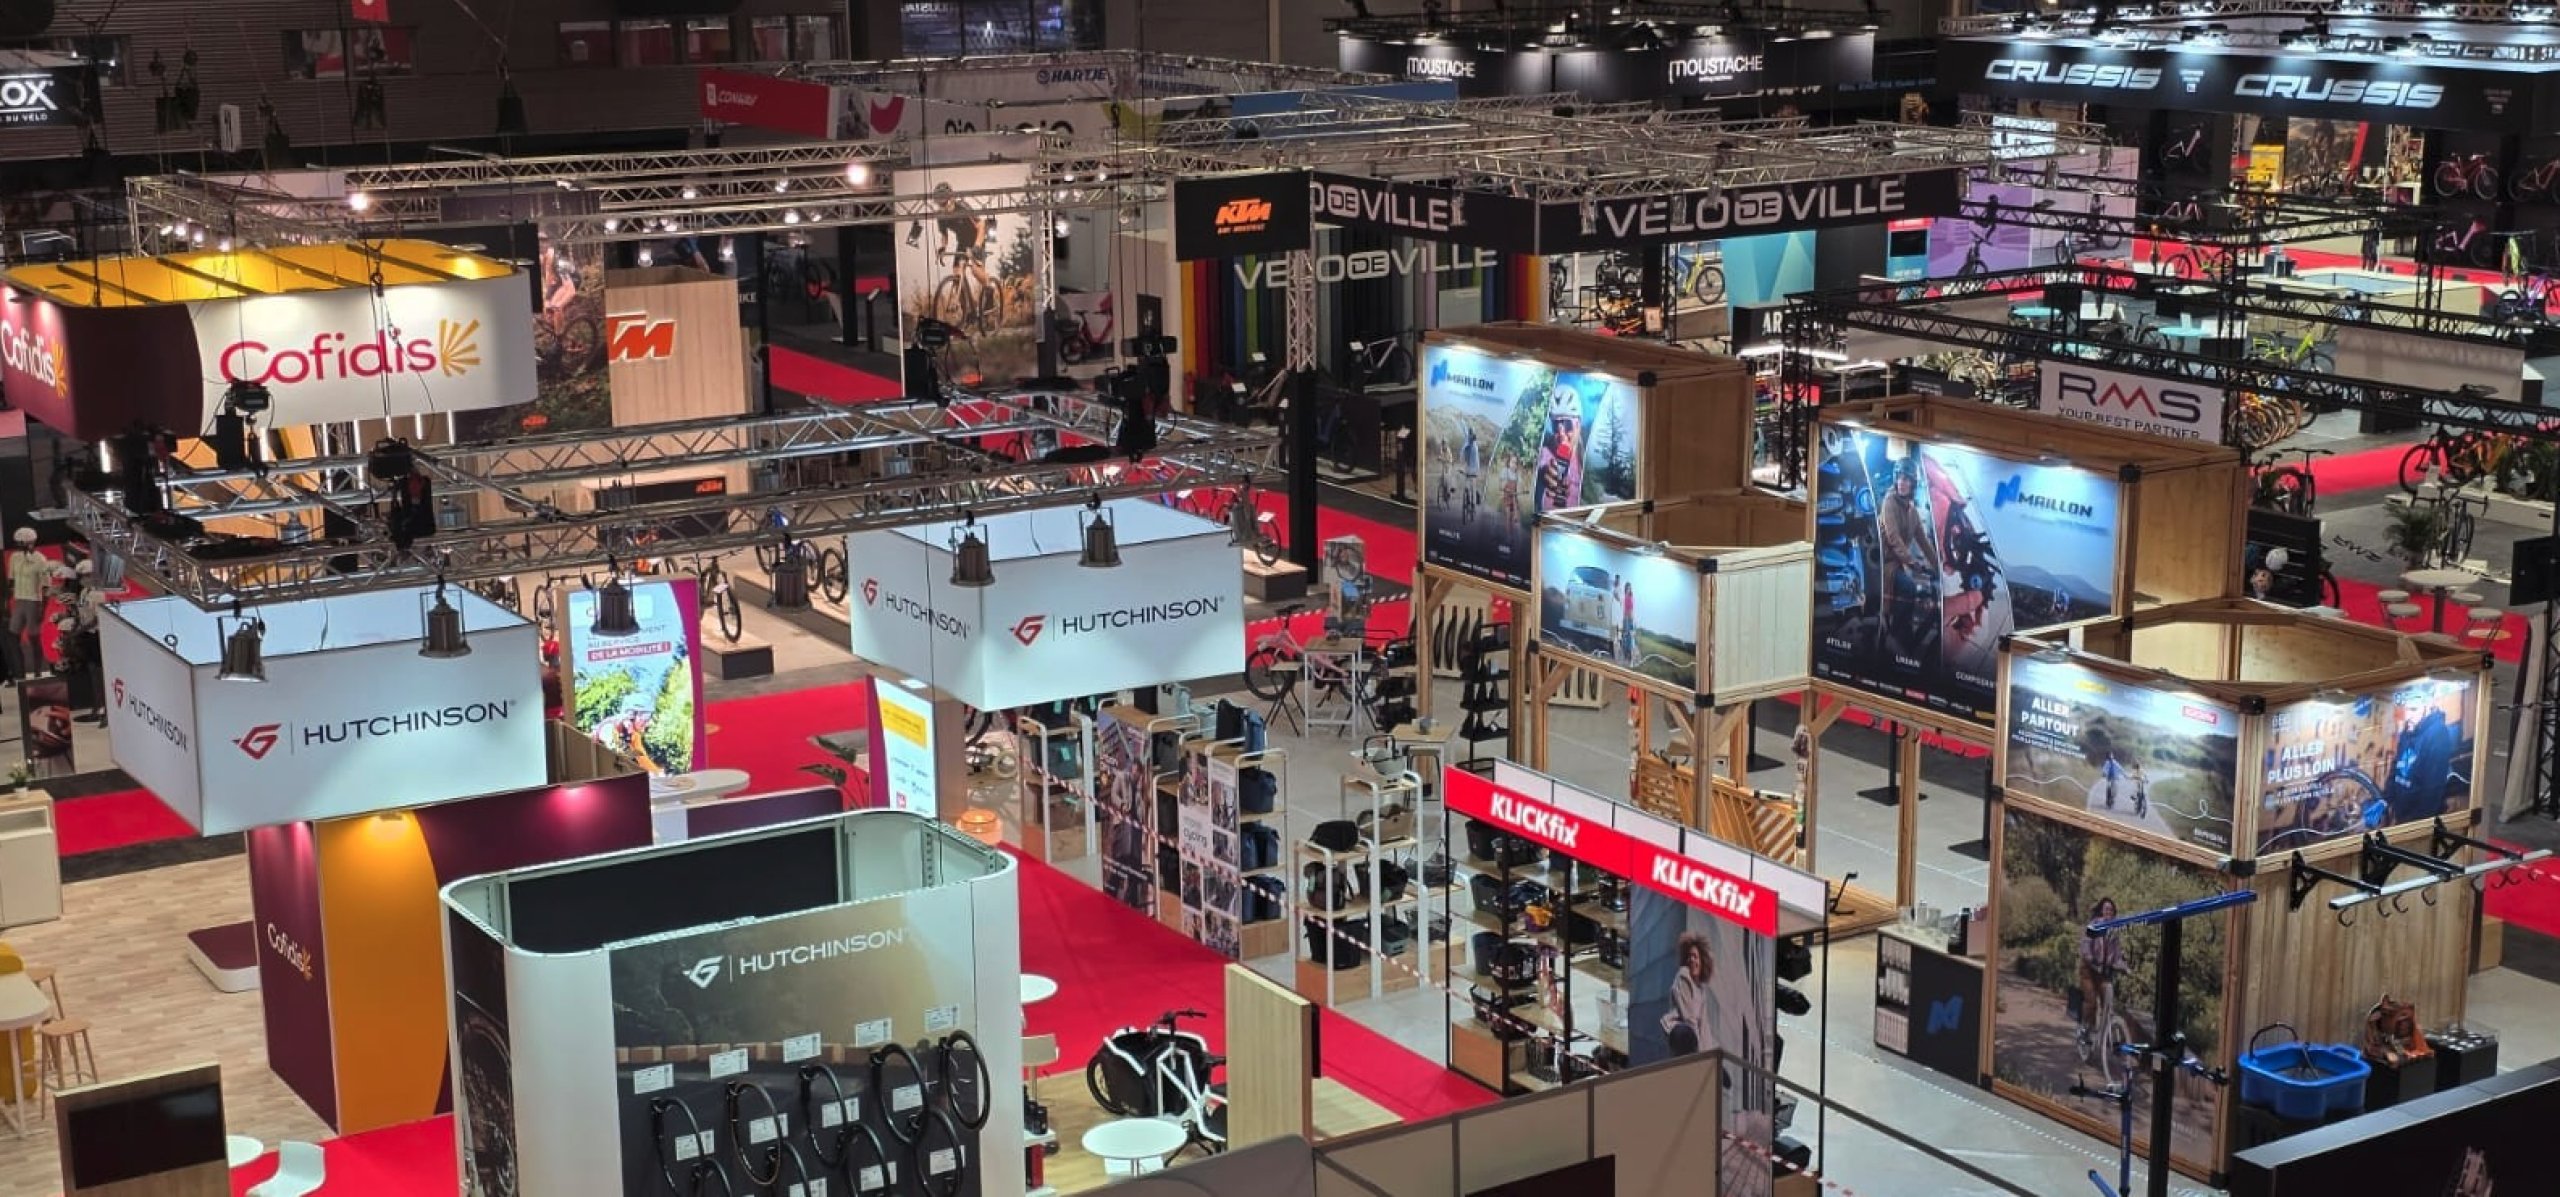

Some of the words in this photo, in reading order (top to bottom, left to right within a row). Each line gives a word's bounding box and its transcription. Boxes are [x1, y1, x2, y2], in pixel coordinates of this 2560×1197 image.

[1407, 57, 1475, 78] MOUSTACHE
[1669, 55, 1762, 84] MOUSTACHE
[1984, 59, 2162, 90] CRUSSIS
[2234, 74, 2445, 108] CRUSSIS
[1215, 198, 1271, 224] KTM
[1362, 190, 1449, 232] VILLE
[1788, 179, 1905, 222] VILLE
[1234, 254, 1344, 290] VEO
[1391, 243, 1498, 275] VILLE
[2, 319, 56, 388] Cofidis
[219, 331, 436, 384] Cofidis
[606, 310, 678, 365] TM
[2058, 371, 2202, 424] RMS
[2058, 406, 2094, 421] YOUR
[2095, 414, 2131, 429] BEST
[2134, 420, 2200, 440] PARTNER
[2018, 492, 2093, 518] MAILLON
[886, 591, 967, 640] HUTCHINSON
[1062, 598, 1220, 636] HUTCHINSON
[303, 699, 509, 746] HUTCHINSON
[2021, 710, 2081, 737] PARTOUT
[2031, 696, 2070, 718] ALLER
[2267, 766, 2302, 784] PLUS
[2304, 758, 2336, 780] LOIN
[2282, 740, 2325, 761] ALLER
[1490, 792, 1580, 849] KLICKfix
[1652, 854, 1755, 919] KLICKfix
[267, 923, 304, 971] Cofidis
[739, 928, 904, 975] HUTCHINSON
